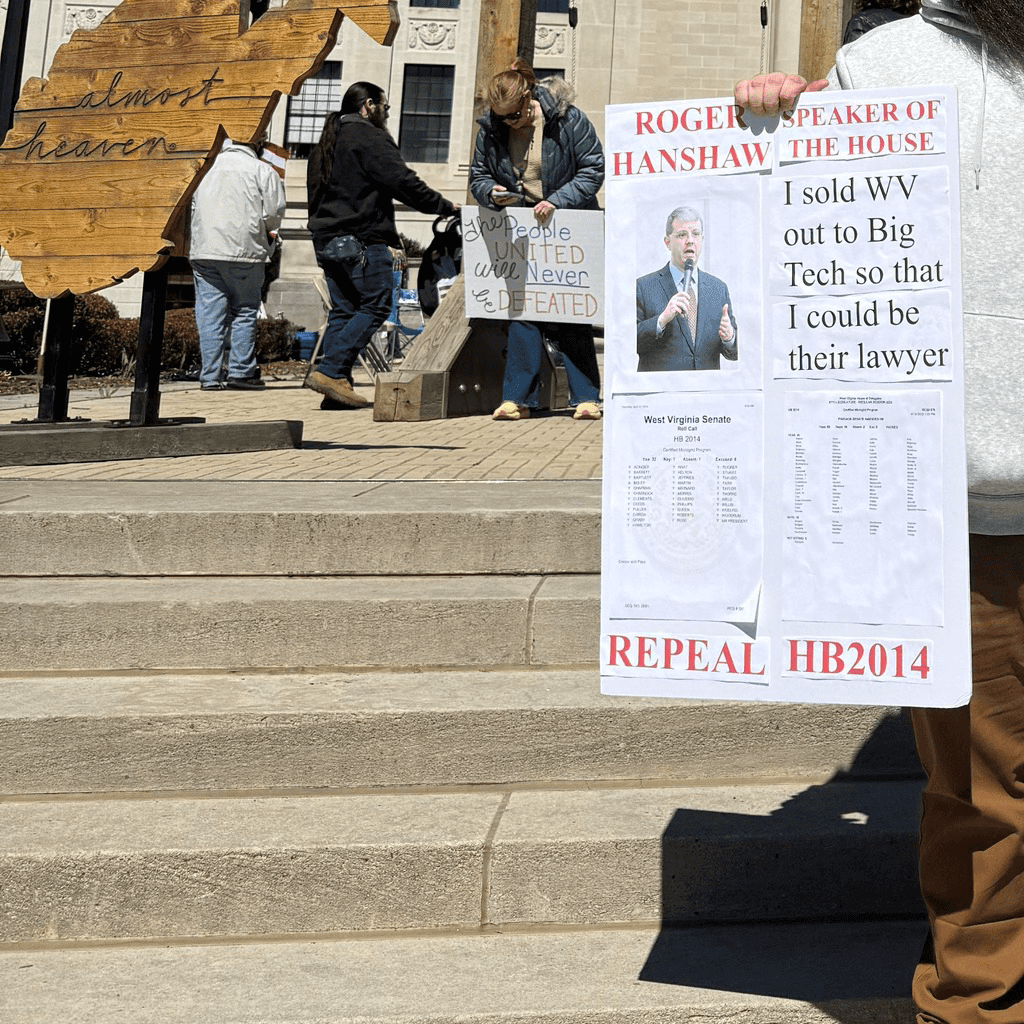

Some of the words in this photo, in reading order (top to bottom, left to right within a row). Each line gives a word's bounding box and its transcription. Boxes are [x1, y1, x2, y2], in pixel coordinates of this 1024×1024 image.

[76, 67, 224, 109] almost
[636, 104, 749, 136] ROGER
[782, 103, 898, 128] SPEAKER
[906, 100, 940, 121] OF
[25, 121, 172, 160] heaven
[788, 137, 839, 158] THE
[848, 132, 934, 154] HOUSE
[613, 142, 771, 176] HANSHAW
[784, 181, 792, 205] I
[803, 177, 855, 204] sold
[865, 175, 918, 201] WV
[464, 215, 502, 242] The
[503, 215, 572, 241] People
[784, 224, 824, 246] out
[834, 223, 857, 243] to
[868, 216, 914, 248] Big
[495, 241, 585, 264] UNITED
[474, 259, 520, 280] will
[526, 261, 590, 286] Never
[784, 260, 845, 286] Tech
[856, 267, 883, 284] so
[893, 257, 943, 283] that
[472, 289, 496, 313] be
[498, 289, 598, 318] DEFEATED
[789, 305, 796, 329] I
[807, 300, 878, 328] could
[888, 300, 919, 325] be
[789, 344, 848, 371] their
[858, 343, 948, 375] lawyer
[667, 416, 699, 425] Virginia
[702, 415, 731, 423] Senate
[608, 635, 765, 677] REPEAL
[788, 640, 930, 679] HB2014
